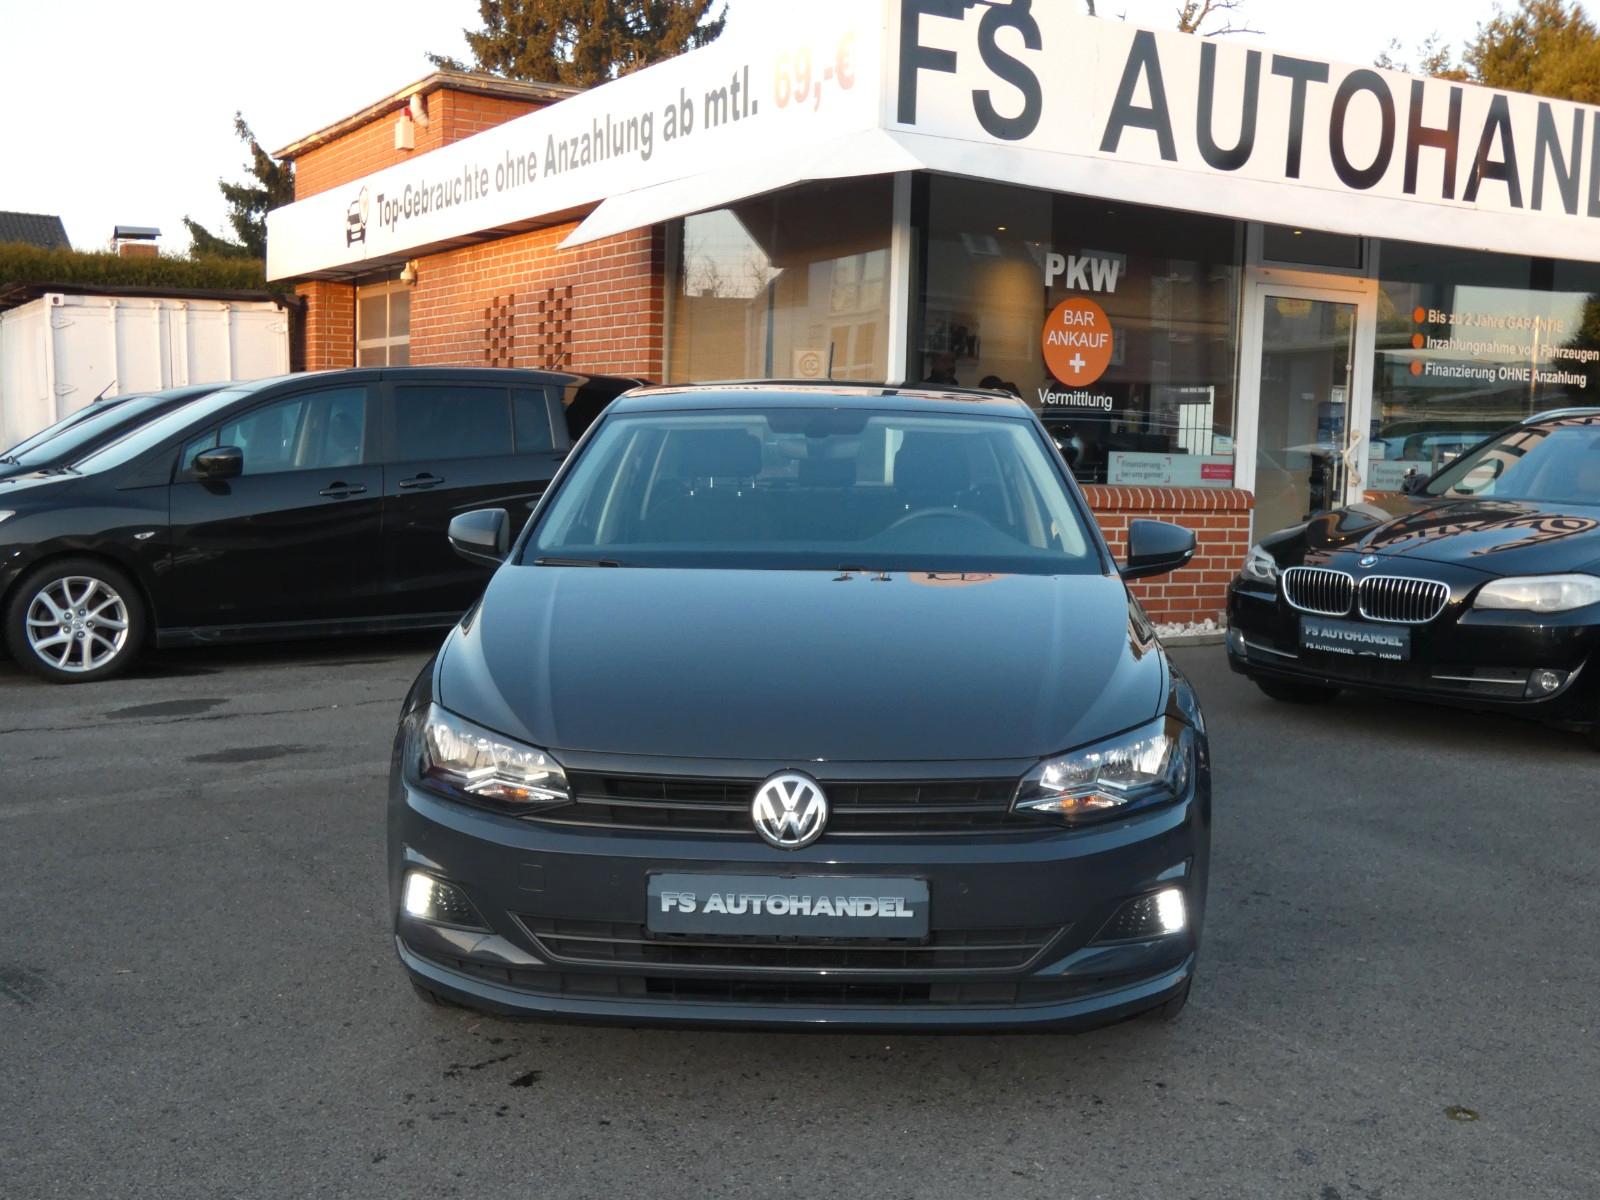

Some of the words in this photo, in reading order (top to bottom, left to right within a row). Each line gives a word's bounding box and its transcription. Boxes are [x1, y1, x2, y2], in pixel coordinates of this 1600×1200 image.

[897, 0, 1043, 141] FS
[1099, 29, 1600, 218] AUTOHAN
[376, 163, 489, 233] Top-Gebrauchte
[495, 149, 537, 192] ohne
[543, 112, 654, 178] Anzahlung
[663, 87, 694, 142] ab
[704, 64, 758, 130] mtl.
[1044, 252, 1121, 294] PKW
[1063, 309, 1095, 327] BAR
[1427, 309, 1447, 325] Bis
[1449, 312, 1462, 326] zu
[1463, 312, 1473, 326] 2
[1474, 314, 1505, 328] Jahre
[1046, 330, 1109, 349] ANKAUF
[1426, 335, 1517, 356] Inzahlungnahme
[1540, 343, 1600, 364] Fahrzeugen
[1425, 361, 1496, 383] Finanzierung
[1498, 366, 1531, 382] OHNE
[1533, 369, 1587, 389] Anzahlung
[1038, 387, 1113, 412] Vermittlung
[1305, 624, 1319, 637] FS
[1321, 628, 1403, 647] AUTOHANDEL
[1305, 642, 1314, 650] FS
[661, 891, 697, 914] FS
[702, 892, 914, 918] AUTOHANDEL
